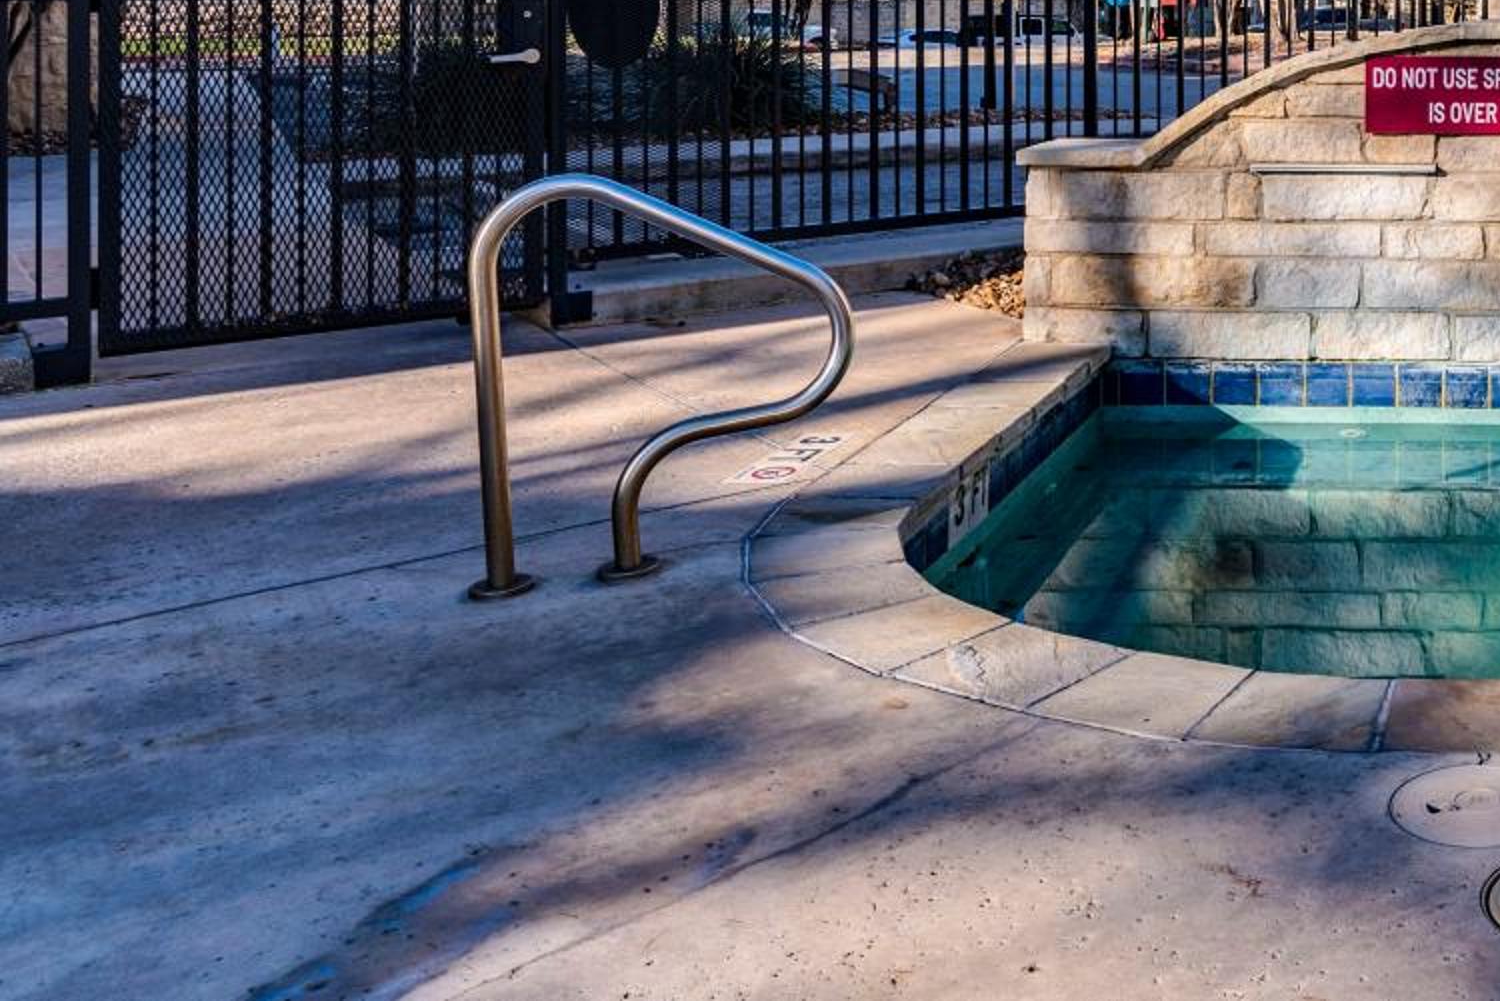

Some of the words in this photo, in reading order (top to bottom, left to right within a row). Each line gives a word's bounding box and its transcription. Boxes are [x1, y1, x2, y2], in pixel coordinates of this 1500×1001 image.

[1372, 66, 1397, 89] DO
[1401, 66, 1438, 90] NOT
[1443, 67, 1479, 90] USE
[1428, 101, 1446, 124] IS
[1450, 101, 1498, 124] OVER
[799, 435, 841, 445] 3
[767, 447, 824, 462] FT
[953, 484, 965, 527] 3
[970, 466, 987, 515] FT
